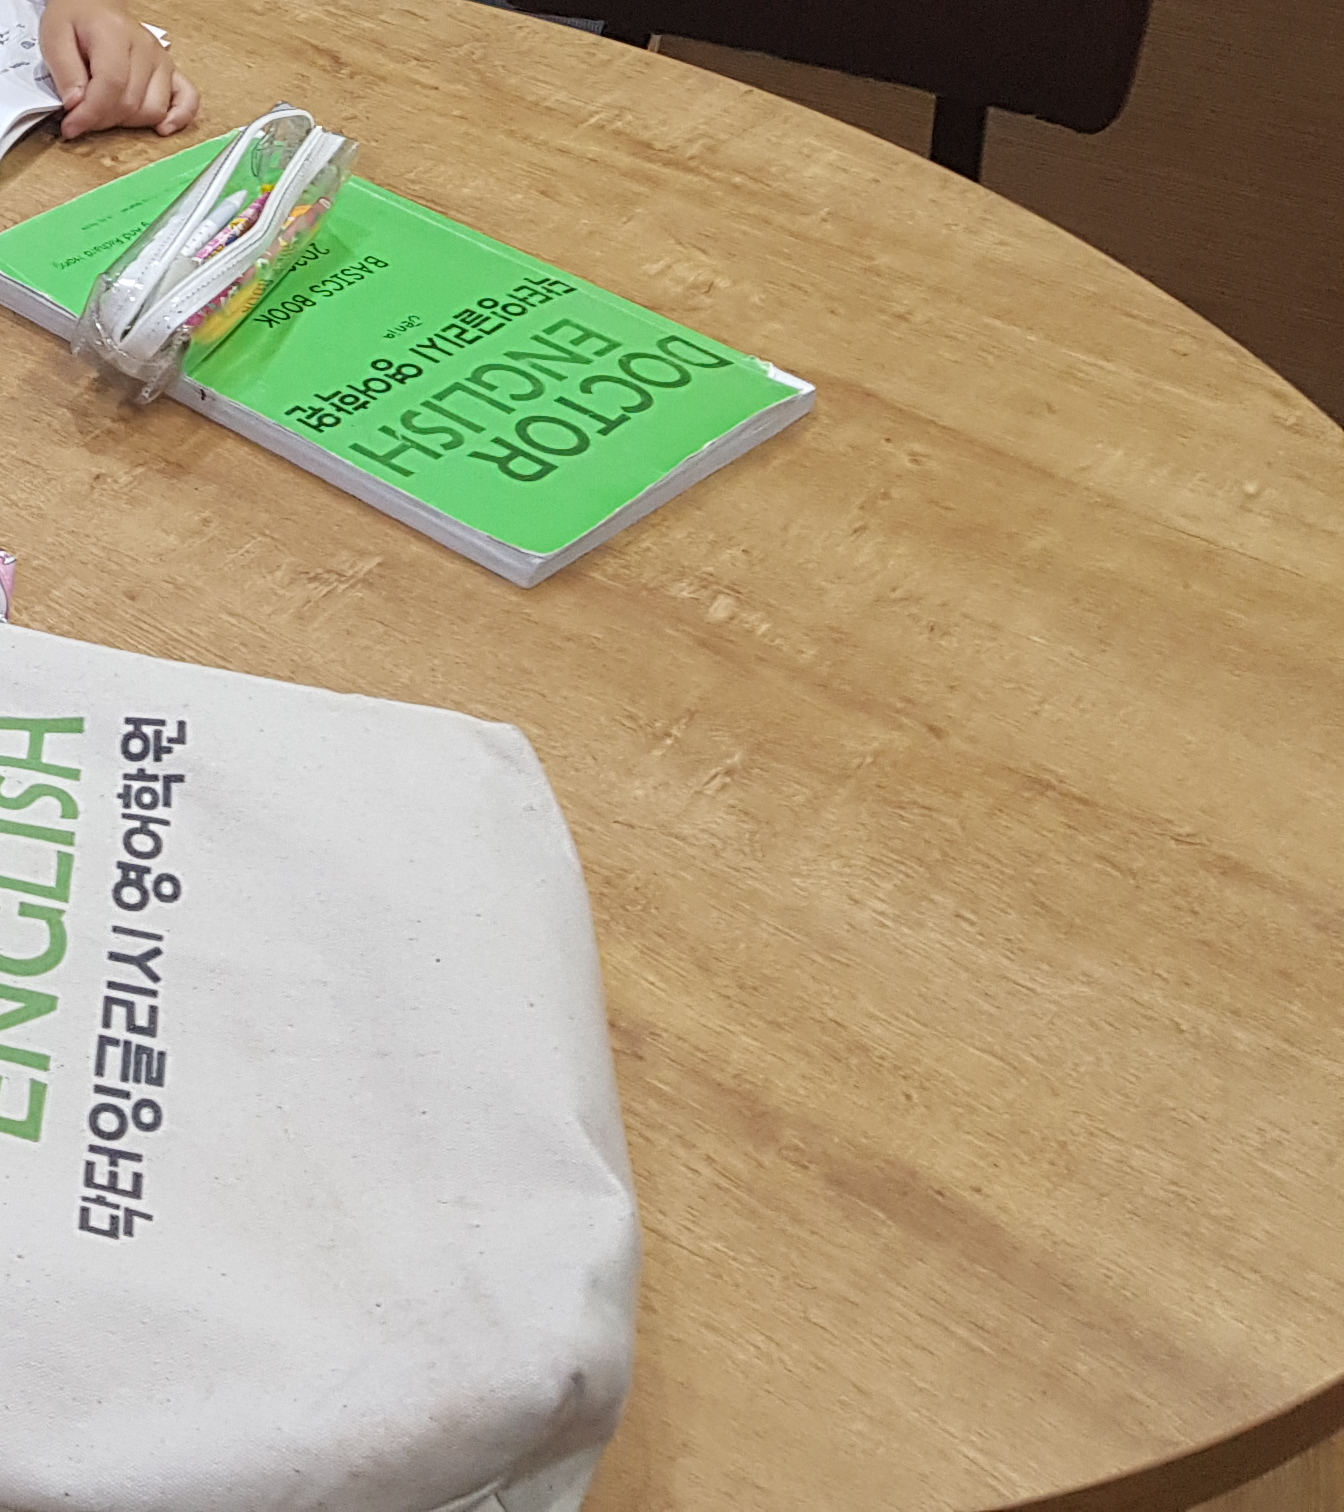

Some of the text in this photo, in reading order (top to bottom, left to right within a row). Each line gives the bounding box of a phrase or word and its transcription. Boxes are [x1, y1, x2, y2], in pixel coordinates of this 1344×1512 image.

[253, 294, 317, 329] BOOK
[308, 255, 390, 298] BASICS
[284, 277, 579, 434] 닥터잉글리시 영어학원
[349, 318, 624, 478] ENGLISH
[467, 334, 733, 483] DOCTOR
[77, 716, 188, 1241] 닥터잉글리시 영어학원
